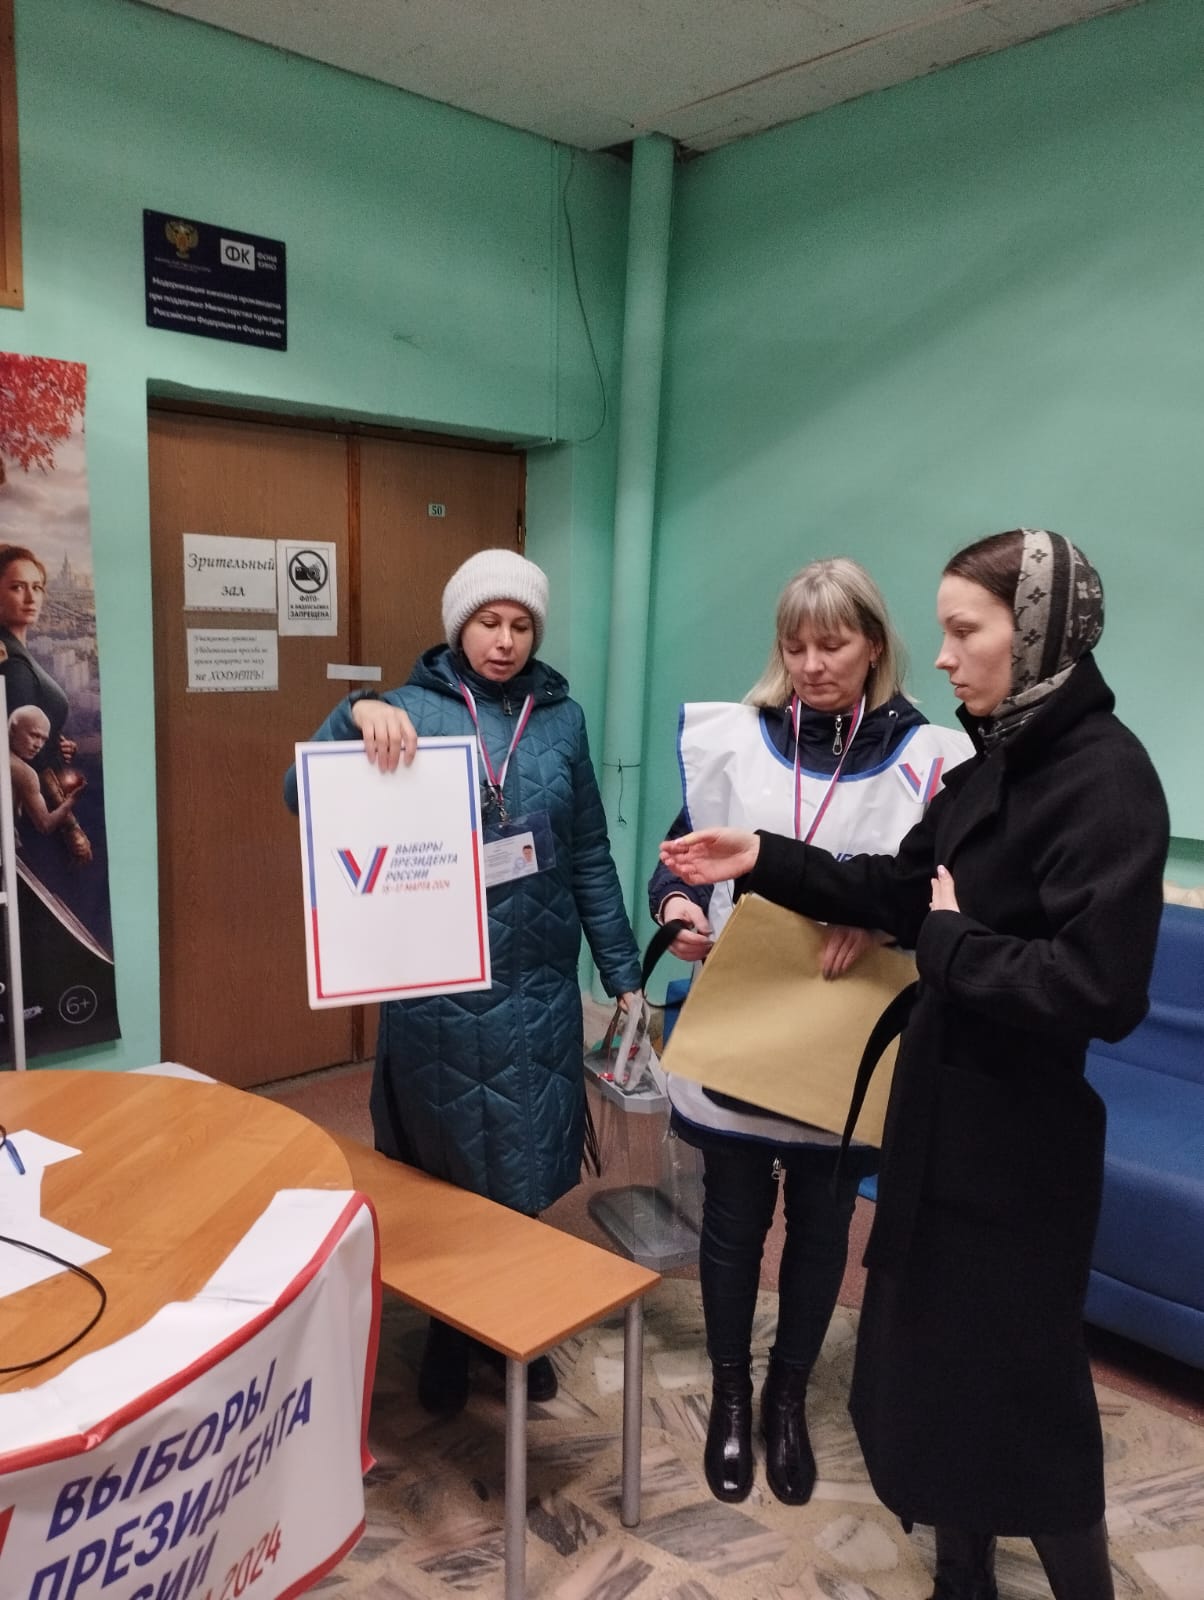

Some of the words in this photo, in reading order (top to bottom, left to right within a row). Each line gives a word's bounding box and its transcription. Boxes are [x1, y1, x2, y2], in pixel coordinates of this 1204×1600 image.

[224, 245, 250, 265] ФК
[153, 306, 196, 322] Российской
[196, 315, 236, 329] Федерации
[242, 323, 265, 336] Фонда
[431, 505, 443, 516] 50
[187, 552, 275, 572] Зрительный
[220, 585, 246, 597] зал
[395, 841, 444, 856] ВЫБОРЫ
[390, 852, 459, 869] ПРЕЗИДЕНТА
[385, 869, 430, 882] РОССИИ
[66, 996, 91, 1015] 6+
[45, 1357, 278, 1542] ВЫБОРЫ
[28, 1377, 313, 1600] ПРЕЗИДЕНТА
